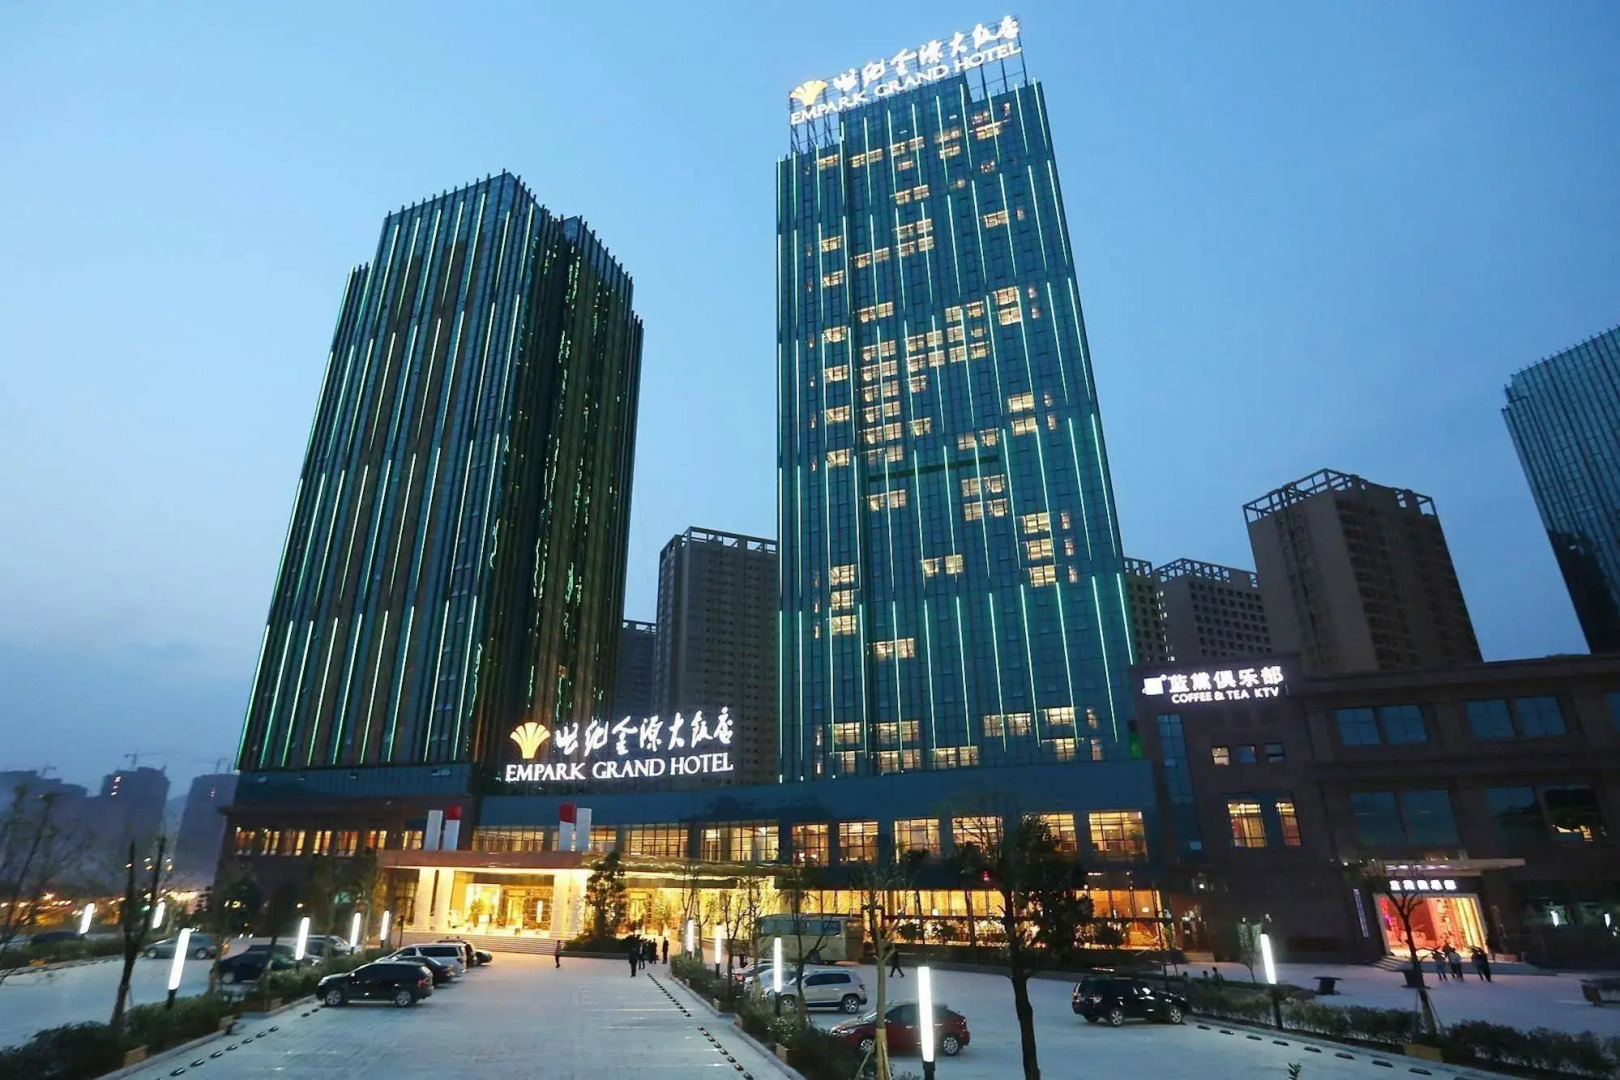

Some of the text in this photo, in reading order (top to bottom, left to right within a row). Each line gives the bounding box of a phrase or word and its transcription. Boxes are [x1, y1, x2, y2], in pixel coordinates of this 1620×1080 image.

[791, 41, 1022, 125] EMPARK GRAND HOTEL
[1171, 686, 1279, 704] COFFEE & TEA KTV
[505, 752, 734, 782] EMPARK GRAND HOTEL
